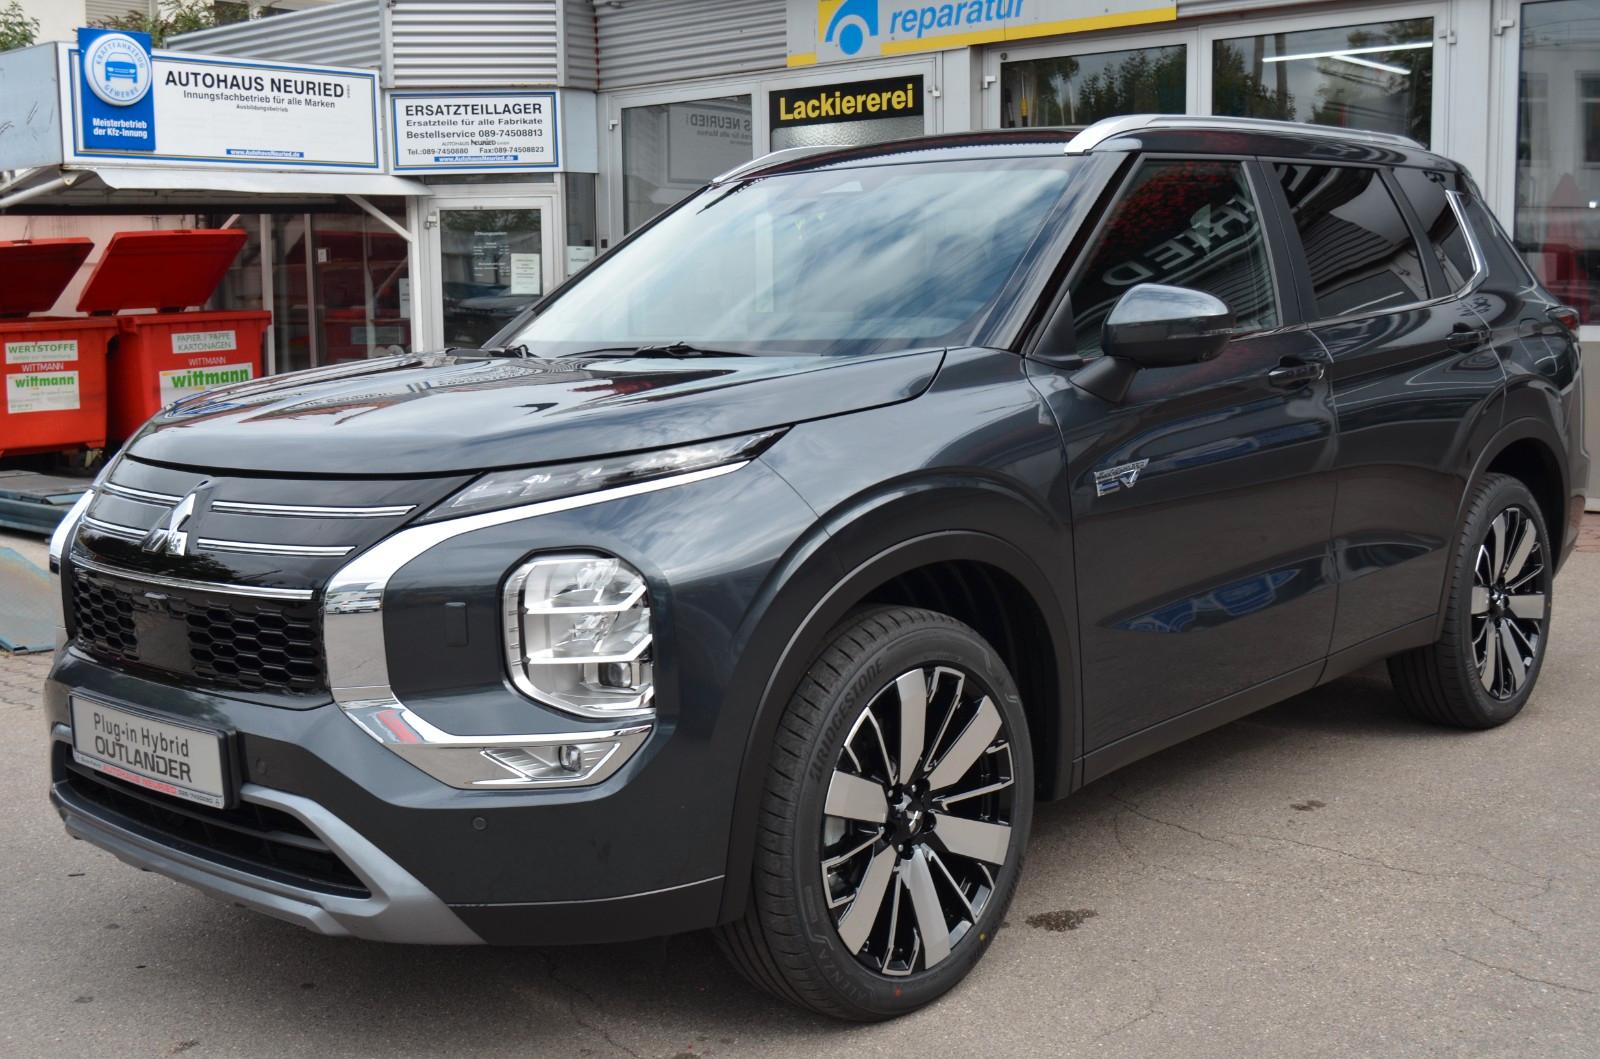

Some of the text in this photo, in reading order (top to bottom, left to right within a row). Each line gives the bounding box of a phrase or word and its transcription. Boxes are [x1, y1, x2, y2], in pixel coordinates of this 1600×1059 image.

[889, 0, 1024, 38] reparatur
[165, 70, 264, 92] AUTOHAUS
[271, 78, 344, 98] NEURIED
[183, 90, 336, 108] Innungsfachbetrieb für alle Marken
[779, 83, 914, 121] Lackiererei
[405, 103, 542, 116] ERSATZTEILLAGER
[92, 118, 147, 129] Meisterbetrieb
[406, 119, 458, 127] Ersatzteile
[461, 118, 475, 126] für
[478, 118, 494, 126] alle
[93, 127, 148, 139] der Kfz-Innung
[406, 128, 543, 139] Bestellservice 089-74508813
[8, 343, 76, 354] WERTSTOFFE
[178, 341, 231, 351] KARTONAGEN
[22, 361, 64, 372] WITTMANN
[188, 356, 226, 366] WITTMANN
[15, 375, 75, 388] wittmann
[171, 368, 249, 388] wittmann
[809, 662, 884, 784] BRIDGESTONE
[93, 712, 189, 758] Plug-in Hybrid
[95, 735, 192, 783] OUTLANDER
